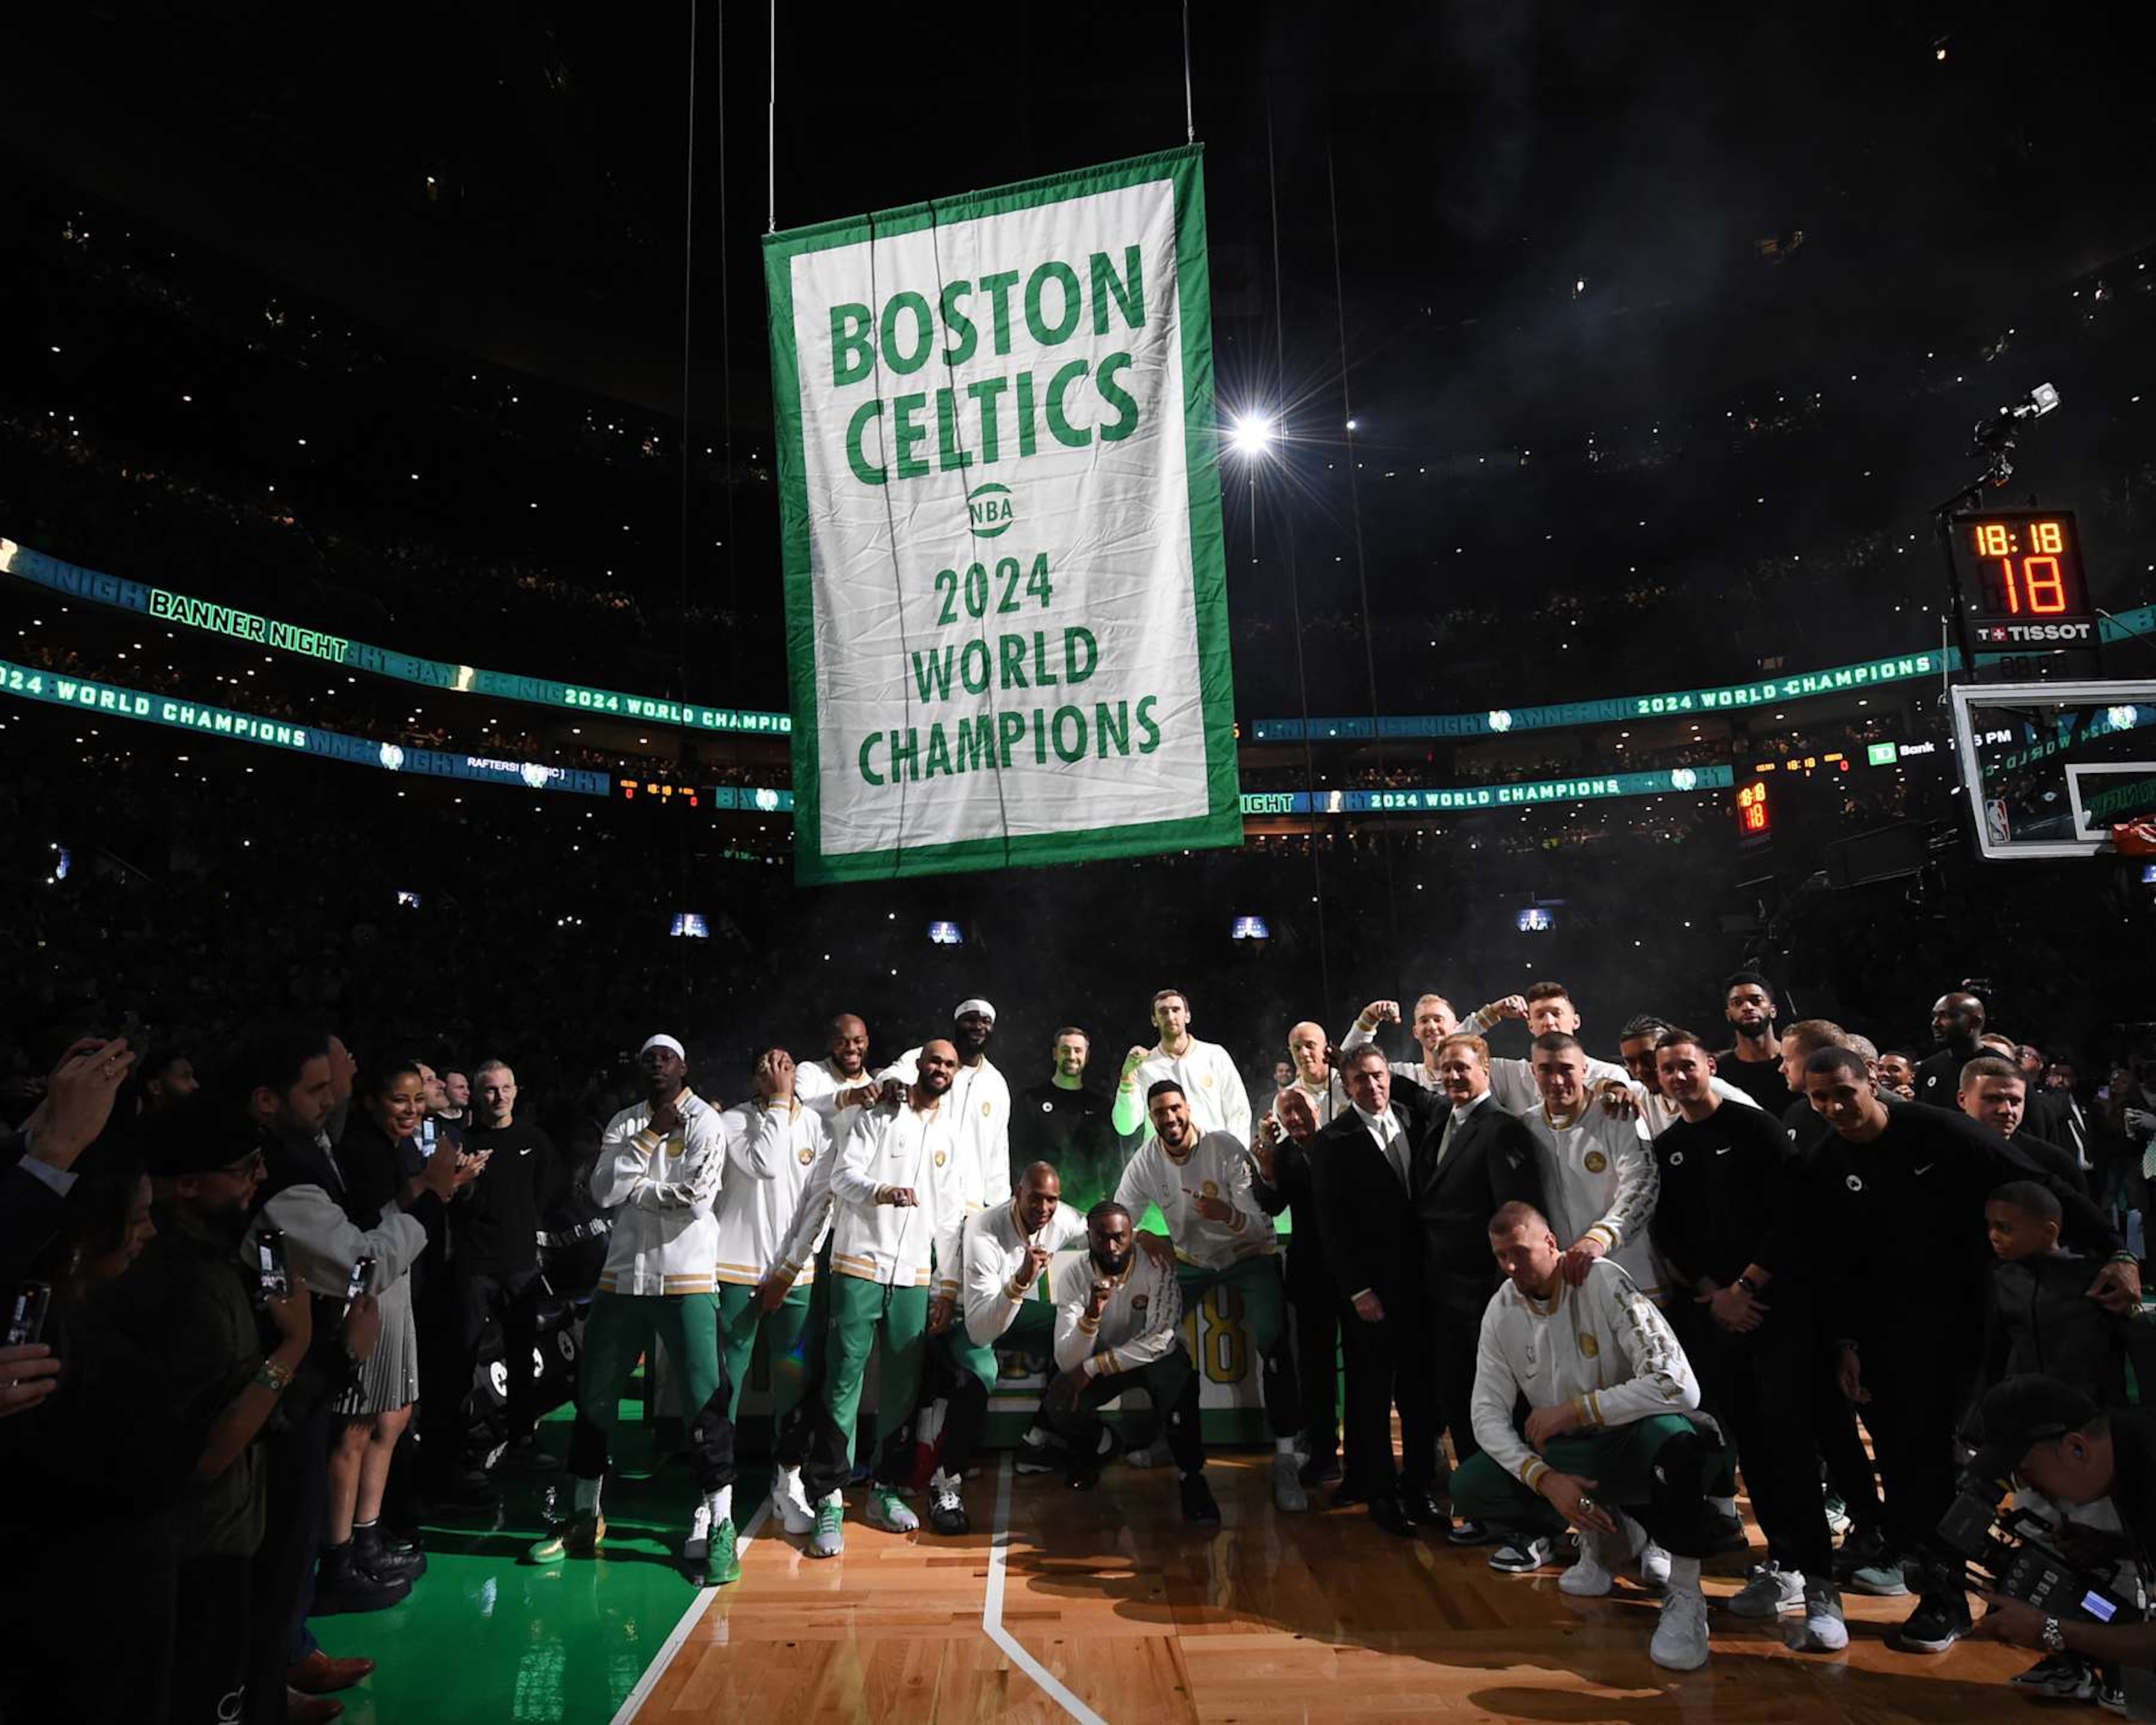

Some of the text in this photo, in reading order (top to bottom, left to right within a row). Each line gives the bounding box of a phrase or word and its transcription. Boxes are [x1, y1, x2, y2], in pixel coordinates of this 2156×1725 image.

[830, 244, 1146, 387] BOSTON
[846, 352, 1139, 485] CELTICS
[968, 498, 1013, 523] NBA
[934, 552, 1053, 626] 2024
[2003, 556, 2066, 613] 18
[149, 588, 266, 642] BANNER
[269, 620, 348, 663] NIGHT
[2008, 623, 2090, 641] TISSOT
[911, 626, 1098, 704] WORLD
[1638, 695, 1692, 713] 2024
[1701, 684, 1776, 707] WORLD
[1785, 656, 1931, 695] CHAMPIONS
[57, 681, 150, 715] WORLD
[162, 702, 306, 747] CHAMPIONS
[565, 689, 618, 711] 2024
[627, 699, 693, 723] WORLD
[858, 695, 1161, 786] CHAMPIONS
[1899, 741, 1935, 757] Bank
[1985, 728, 2012, 745] PM
[1371, 793, 1418, 807] 2024
[1426, 791, 1490, 806] WORLD
[1499, 779, 1620, 802] CHAMPIONS
